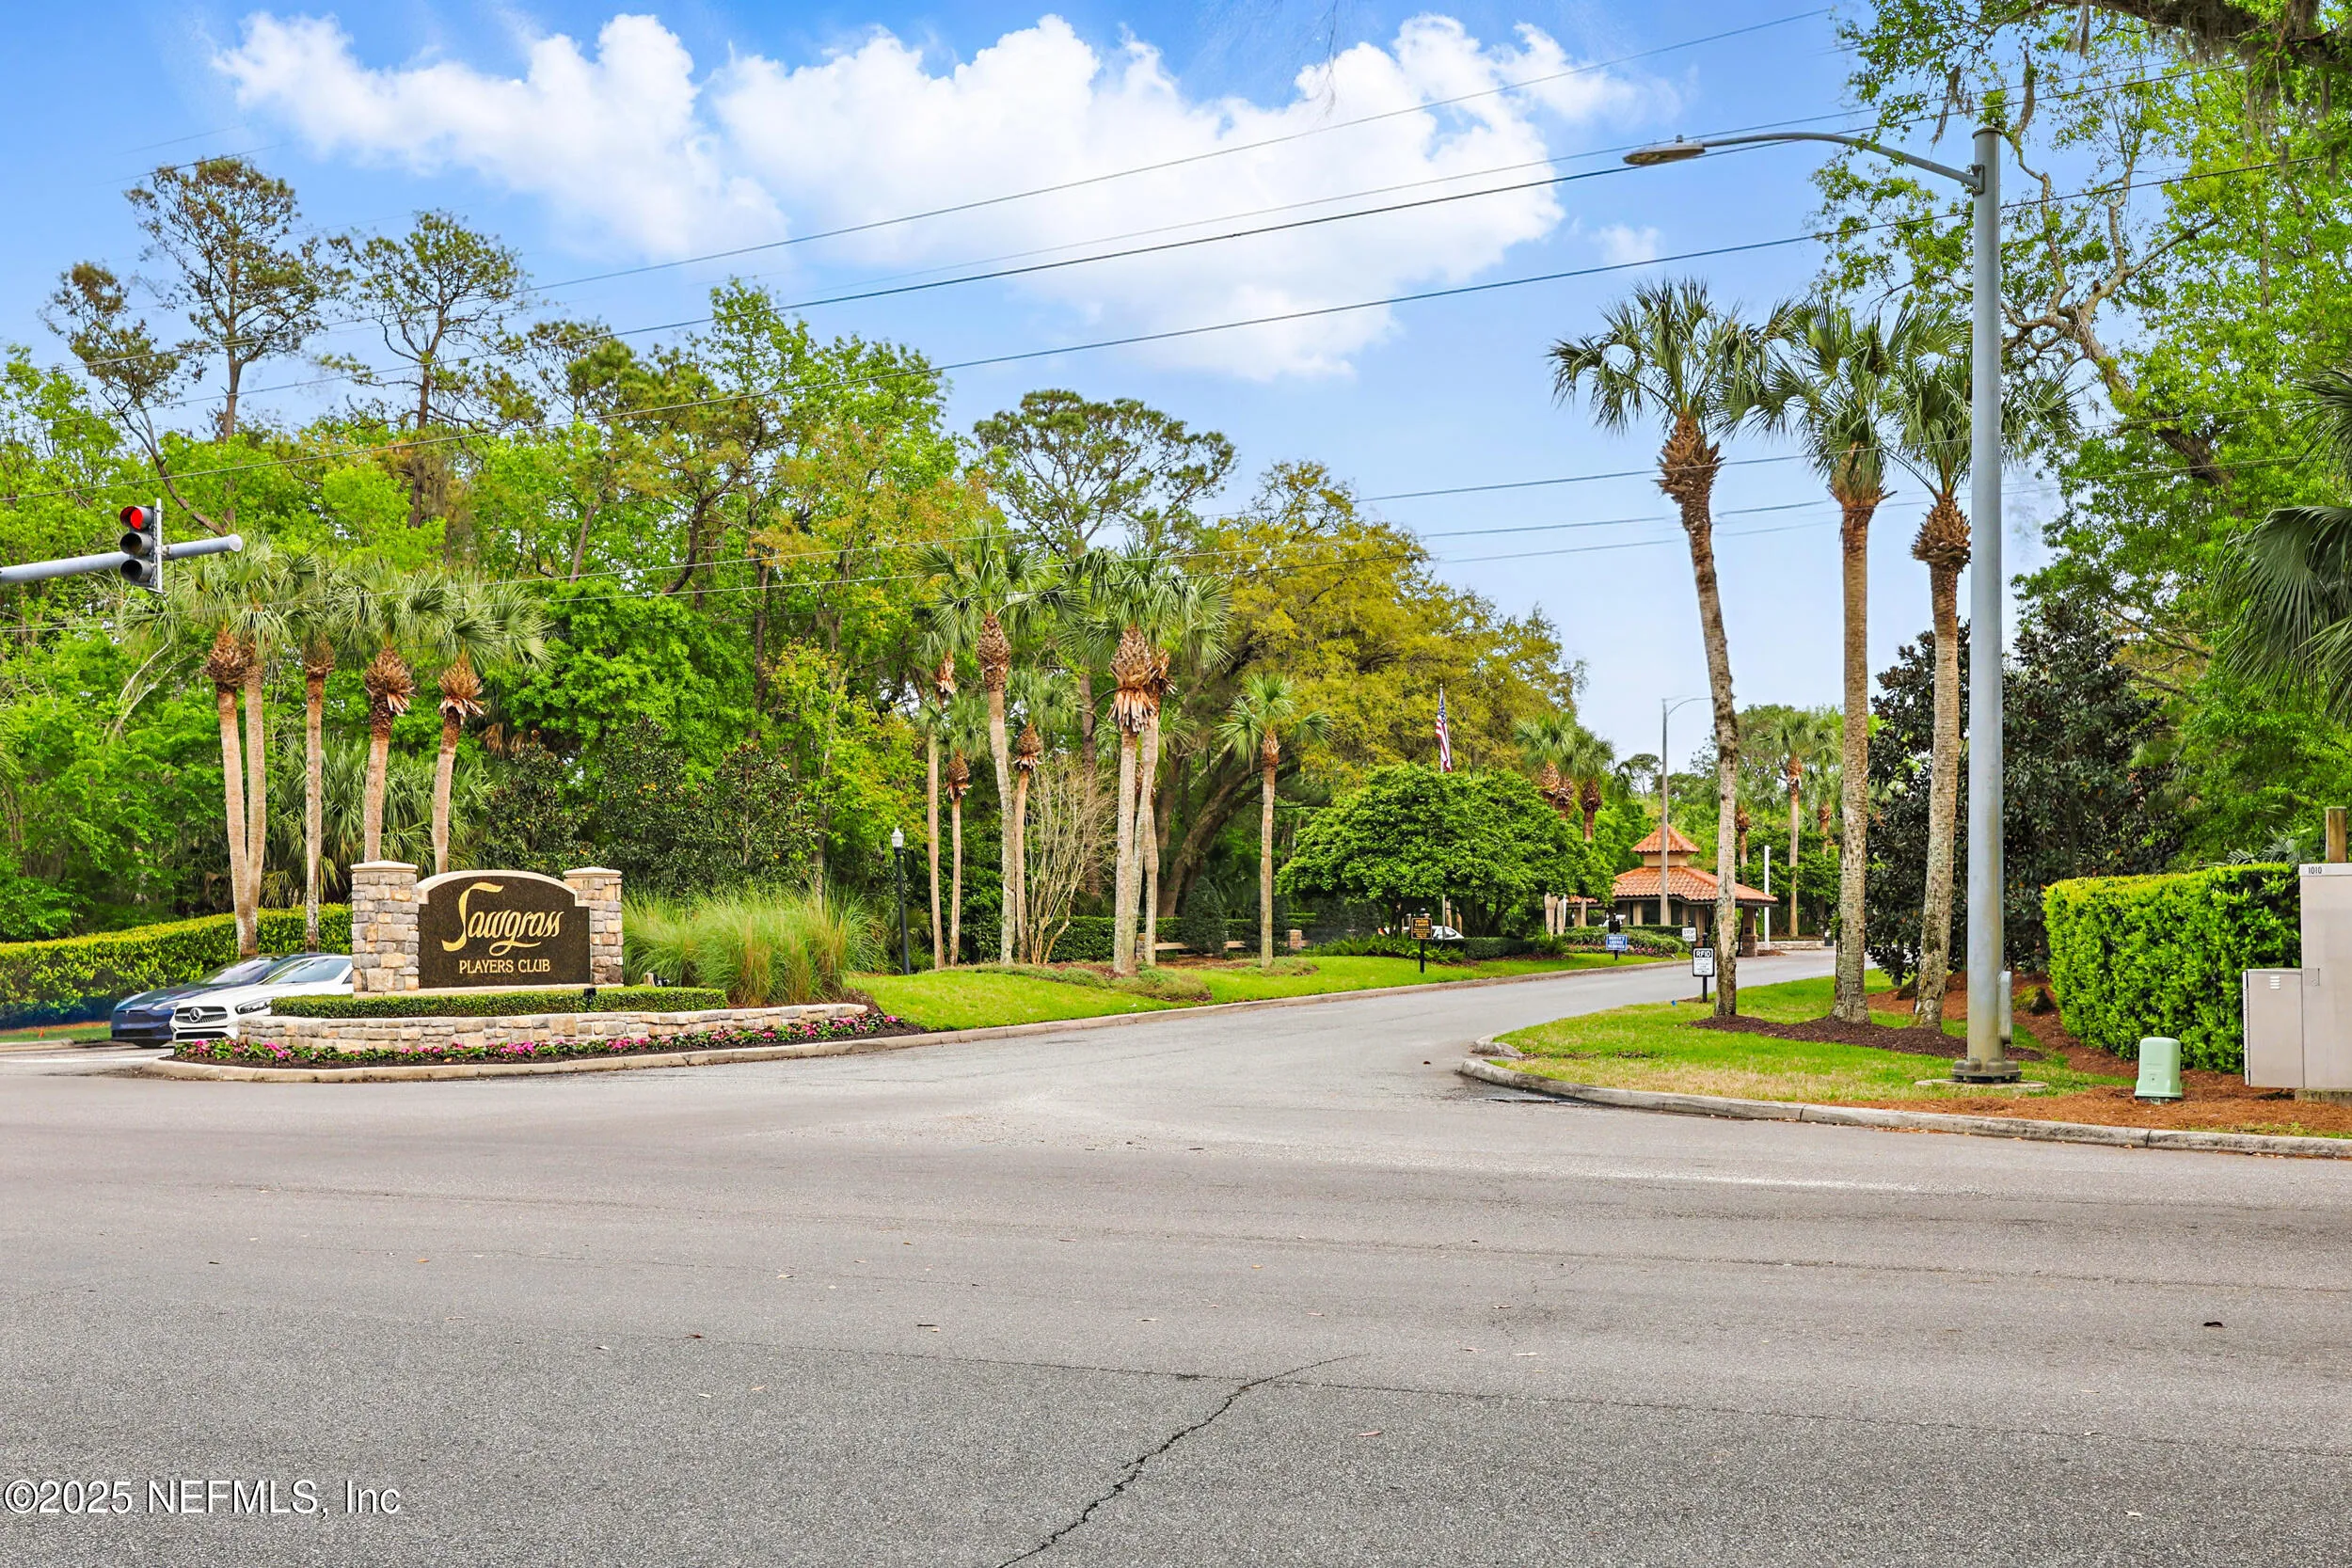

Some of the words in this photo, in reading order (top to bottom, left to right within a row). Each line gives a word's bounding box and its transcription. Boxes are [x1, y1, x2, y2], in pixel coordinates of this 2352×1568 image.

[2308, 865, 2323, 875] 1010
[441, 881, 564, 957] Sawgrass
[458, 959, 514, 974] PLAYERS
[517, 958, 550, 973] CLUB
